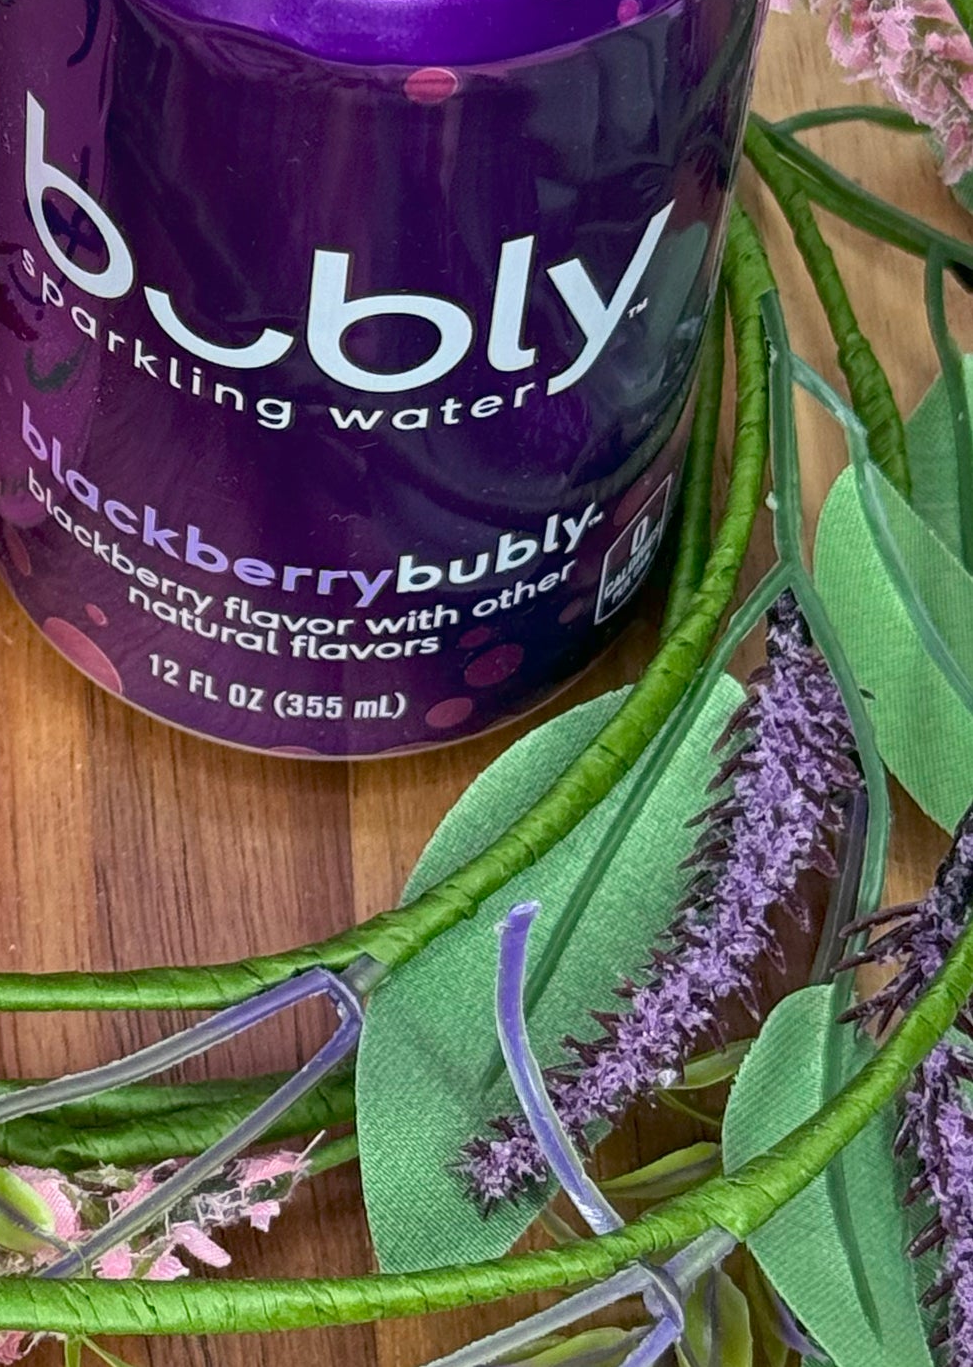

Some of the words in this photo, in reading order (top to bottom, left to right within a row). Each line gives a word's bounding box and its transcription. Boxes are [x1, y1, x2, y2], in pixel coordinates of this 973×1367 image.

[22, 248, 293, 430] sparkling
[328, 381, 536, 431] water
[28, 466, 213, 616] blackberry
[224, 596, 355, 636] flavor
[364, 603, 460, 635] with
[472, 559, 577, 618] other
[128, 585, 279, 656] natural
[290, 634, 441, 661] flavors
[148, 652, 180, 687] 12
[189, 668, 220, 702] FL
[228, 682, 265, 712] OZ
[273, 690, 344, 720] (355
[353, 691, 406, 720] mL)
